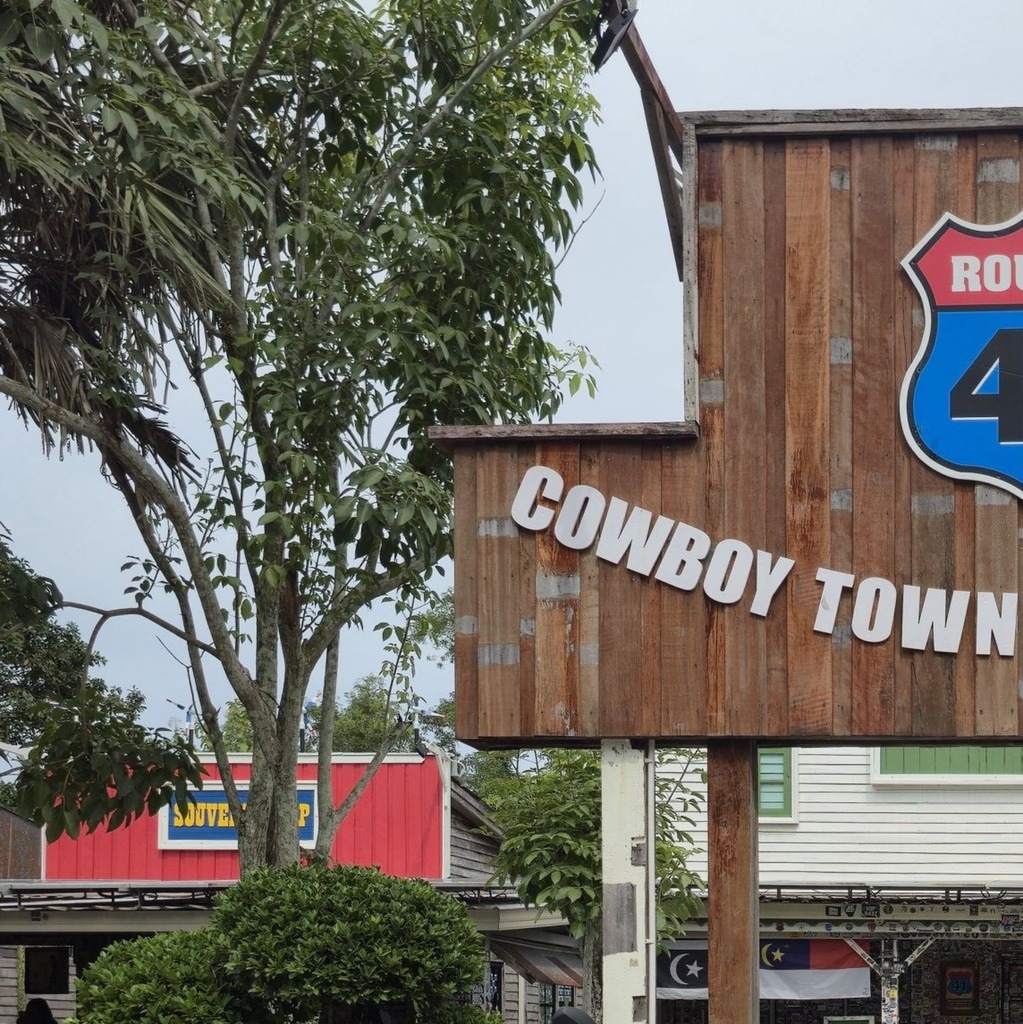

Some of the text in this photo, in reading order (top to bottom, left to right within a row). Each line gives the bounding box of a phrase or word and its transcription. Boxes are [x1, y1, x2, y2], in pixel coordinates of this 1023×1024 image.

[510, 465, 795, 617] COWBOY
[814, 567, 1019, 657] TOWN
[173, 803, 247, 827] SOUVE
